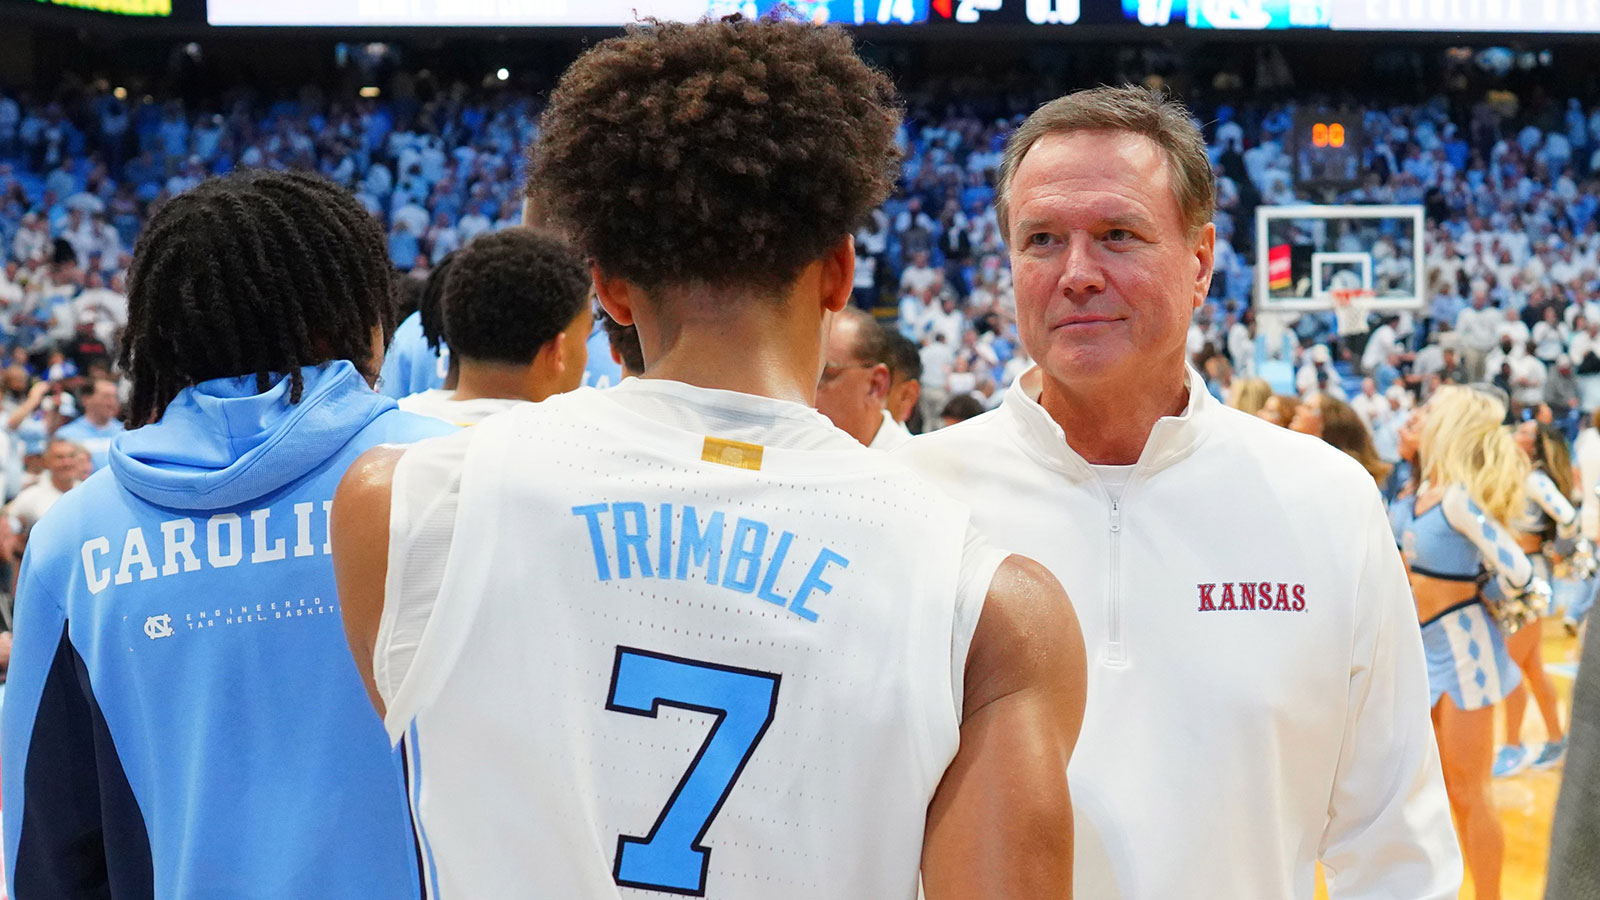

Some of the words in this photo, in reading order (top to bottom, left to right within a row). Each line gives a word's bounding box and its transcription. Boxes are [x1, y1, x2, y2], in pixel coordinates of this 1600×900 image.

[571, 501, 850, 623] TRIMBLE
[186, 597, 321, 621] ENGINEERED
[1197, 581, 1306, 612] KANSAS
[188, 619, 214, 630] TAR
[275, 604, 342, 619] BASKET
[604, 644, 782, 898] 7
